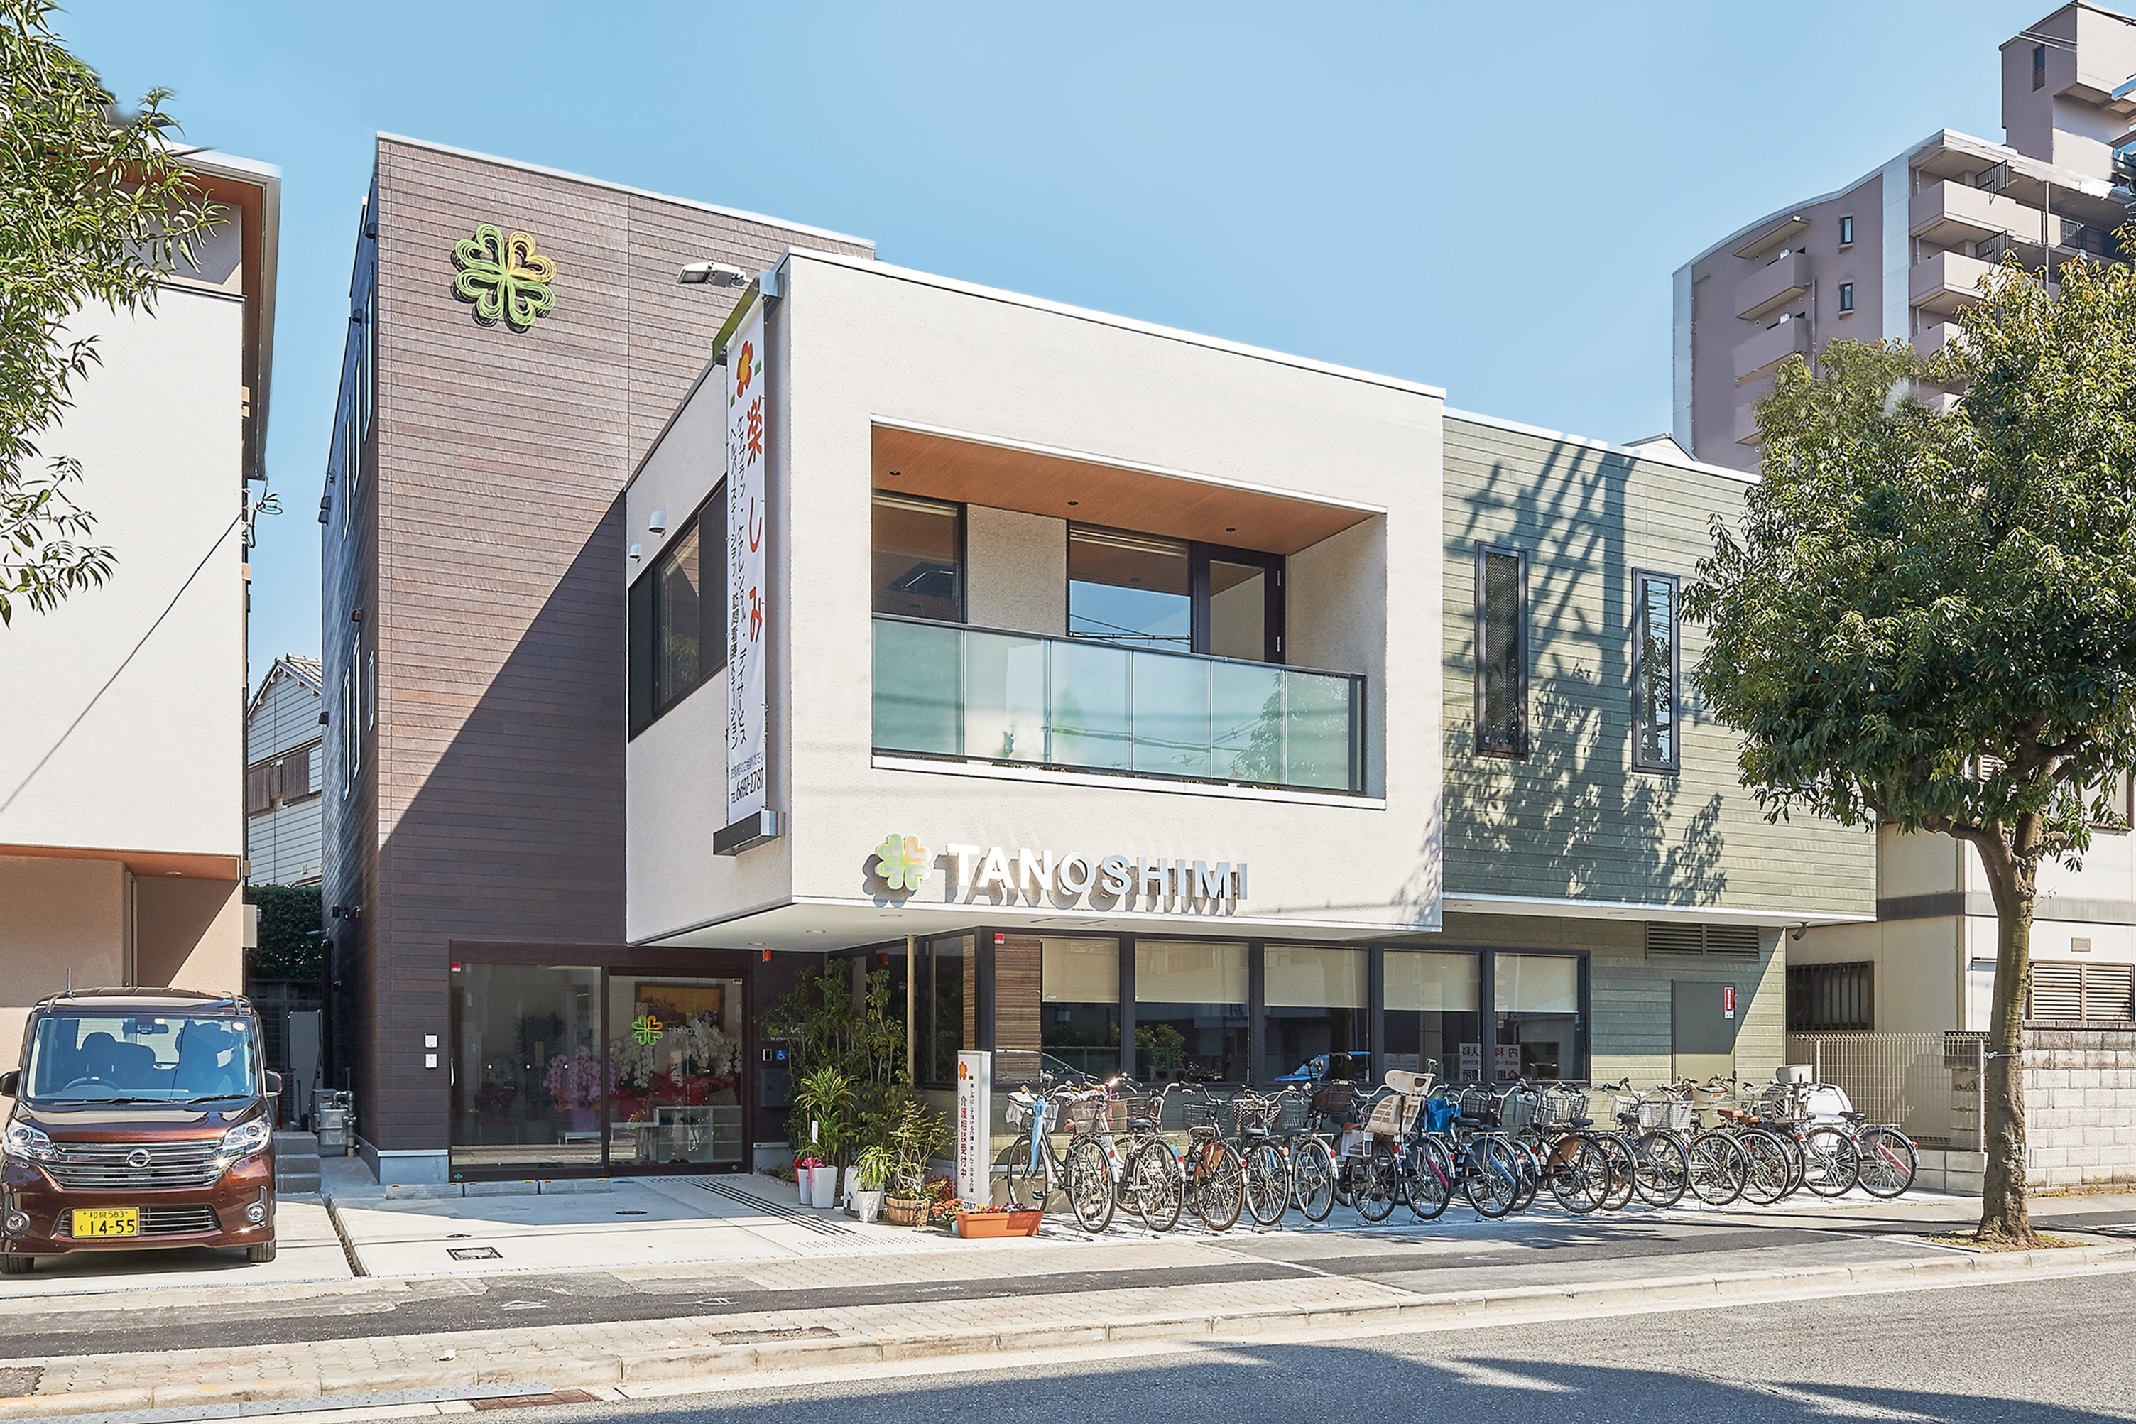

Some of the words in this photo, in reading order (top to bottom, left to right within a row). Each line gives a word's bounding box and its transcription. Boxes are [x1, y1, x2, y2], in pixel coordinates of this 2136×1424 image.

[747, 396, 763, 643] 楽しみ
[945, 843, 1249, 900] TANOSHIMI
[90, 1219, 135, 1234] 14-55
